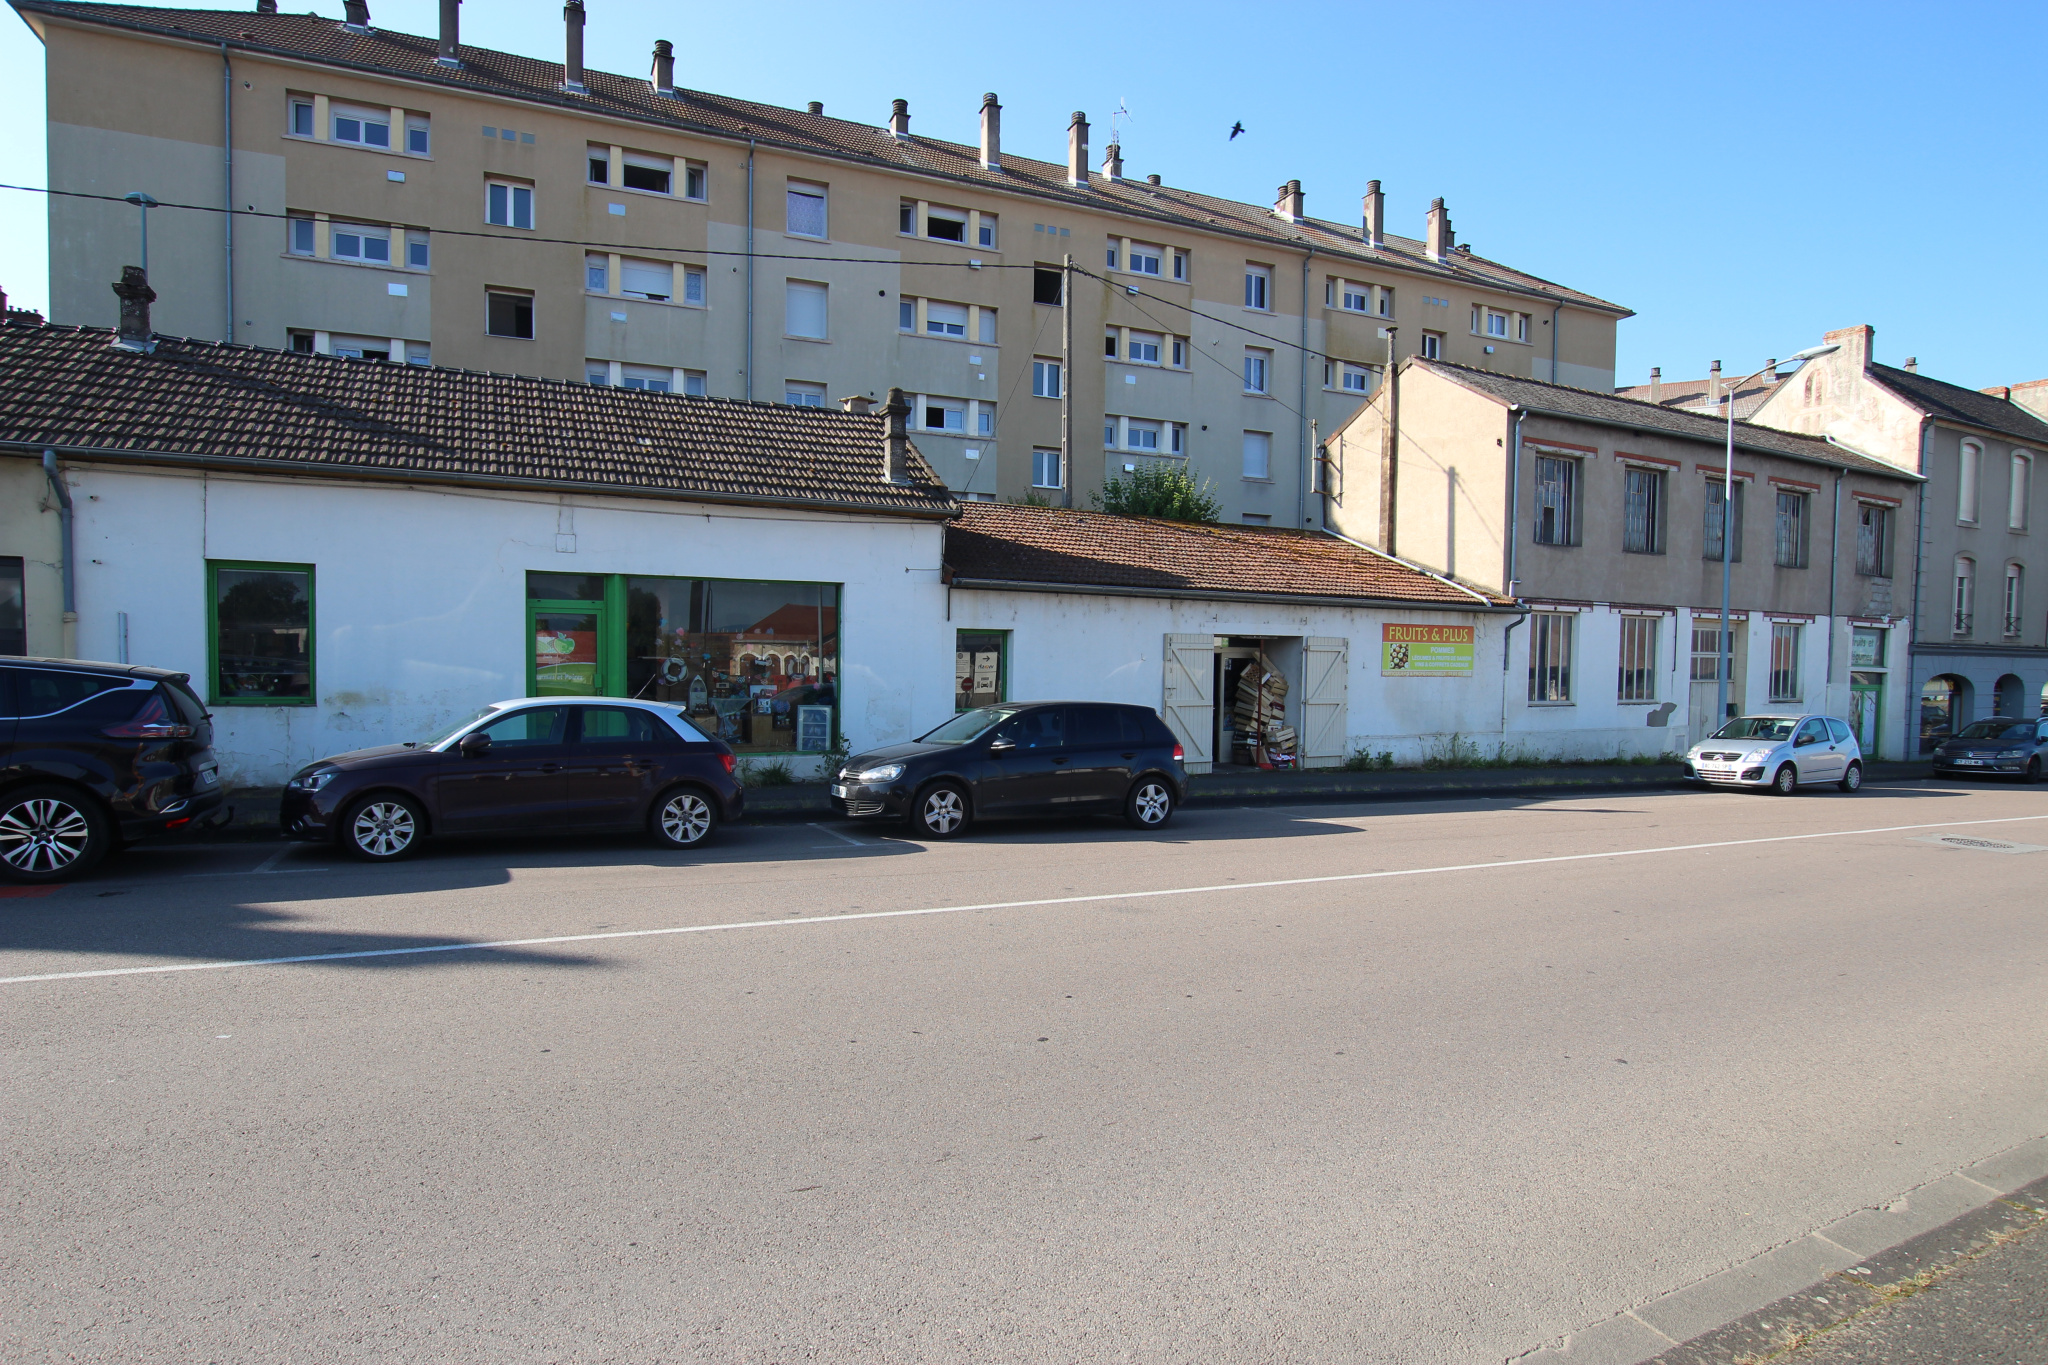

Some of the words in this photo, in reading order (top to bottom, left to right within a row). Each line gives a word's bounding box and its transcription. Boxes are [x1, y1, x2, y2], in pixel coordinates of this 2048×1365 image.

[1389, 626, 1428, 641] FRUITS
[1431, 628, 1440, 641] &
[1443, 628, 1468, 642] PLUS
